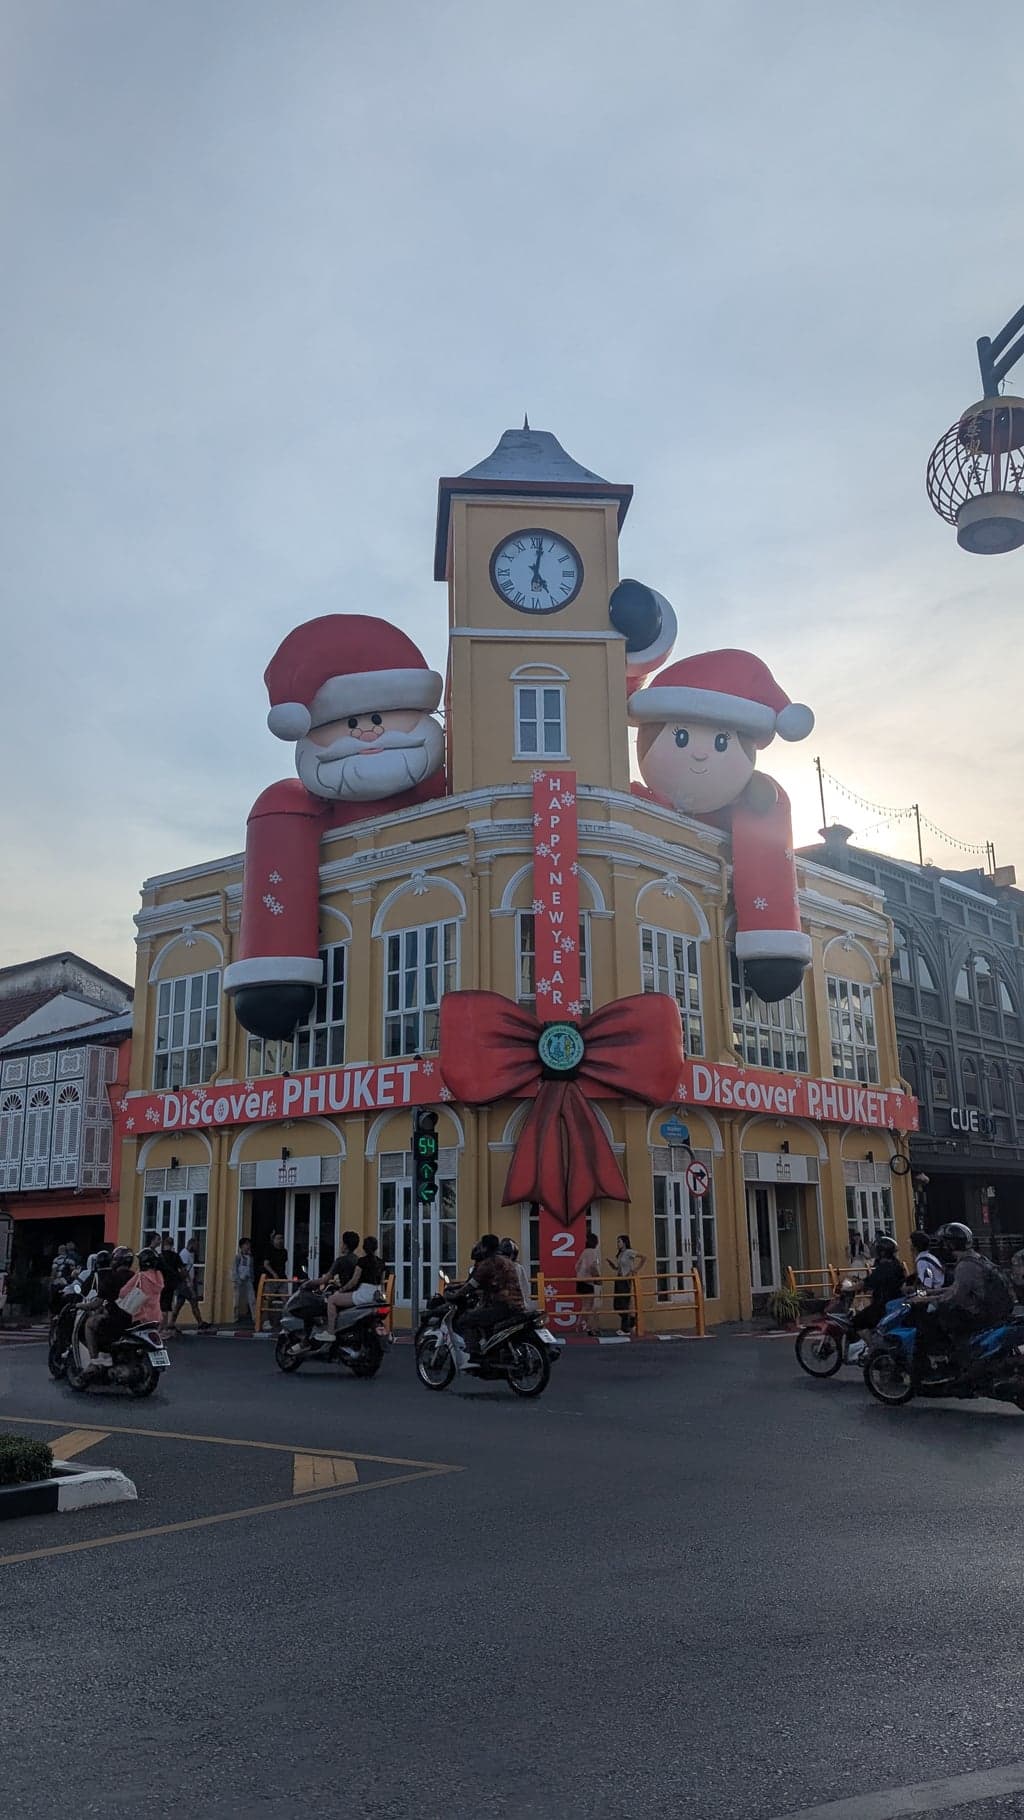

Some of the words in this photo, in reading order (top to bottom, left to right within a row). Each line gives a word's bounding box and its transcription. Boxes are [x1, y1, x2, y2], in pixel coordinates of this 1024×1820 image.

[162, 1089, 273, 1128] Discover
[282, 1063, 419, 1115] PHUKET
[692, 1064, 797, 1112] Discover
[807, 1082, 888, 1126] PHUKET
[950, 1107, 979, 1132] CUE
[418, 1137, 435, 1154] 54
